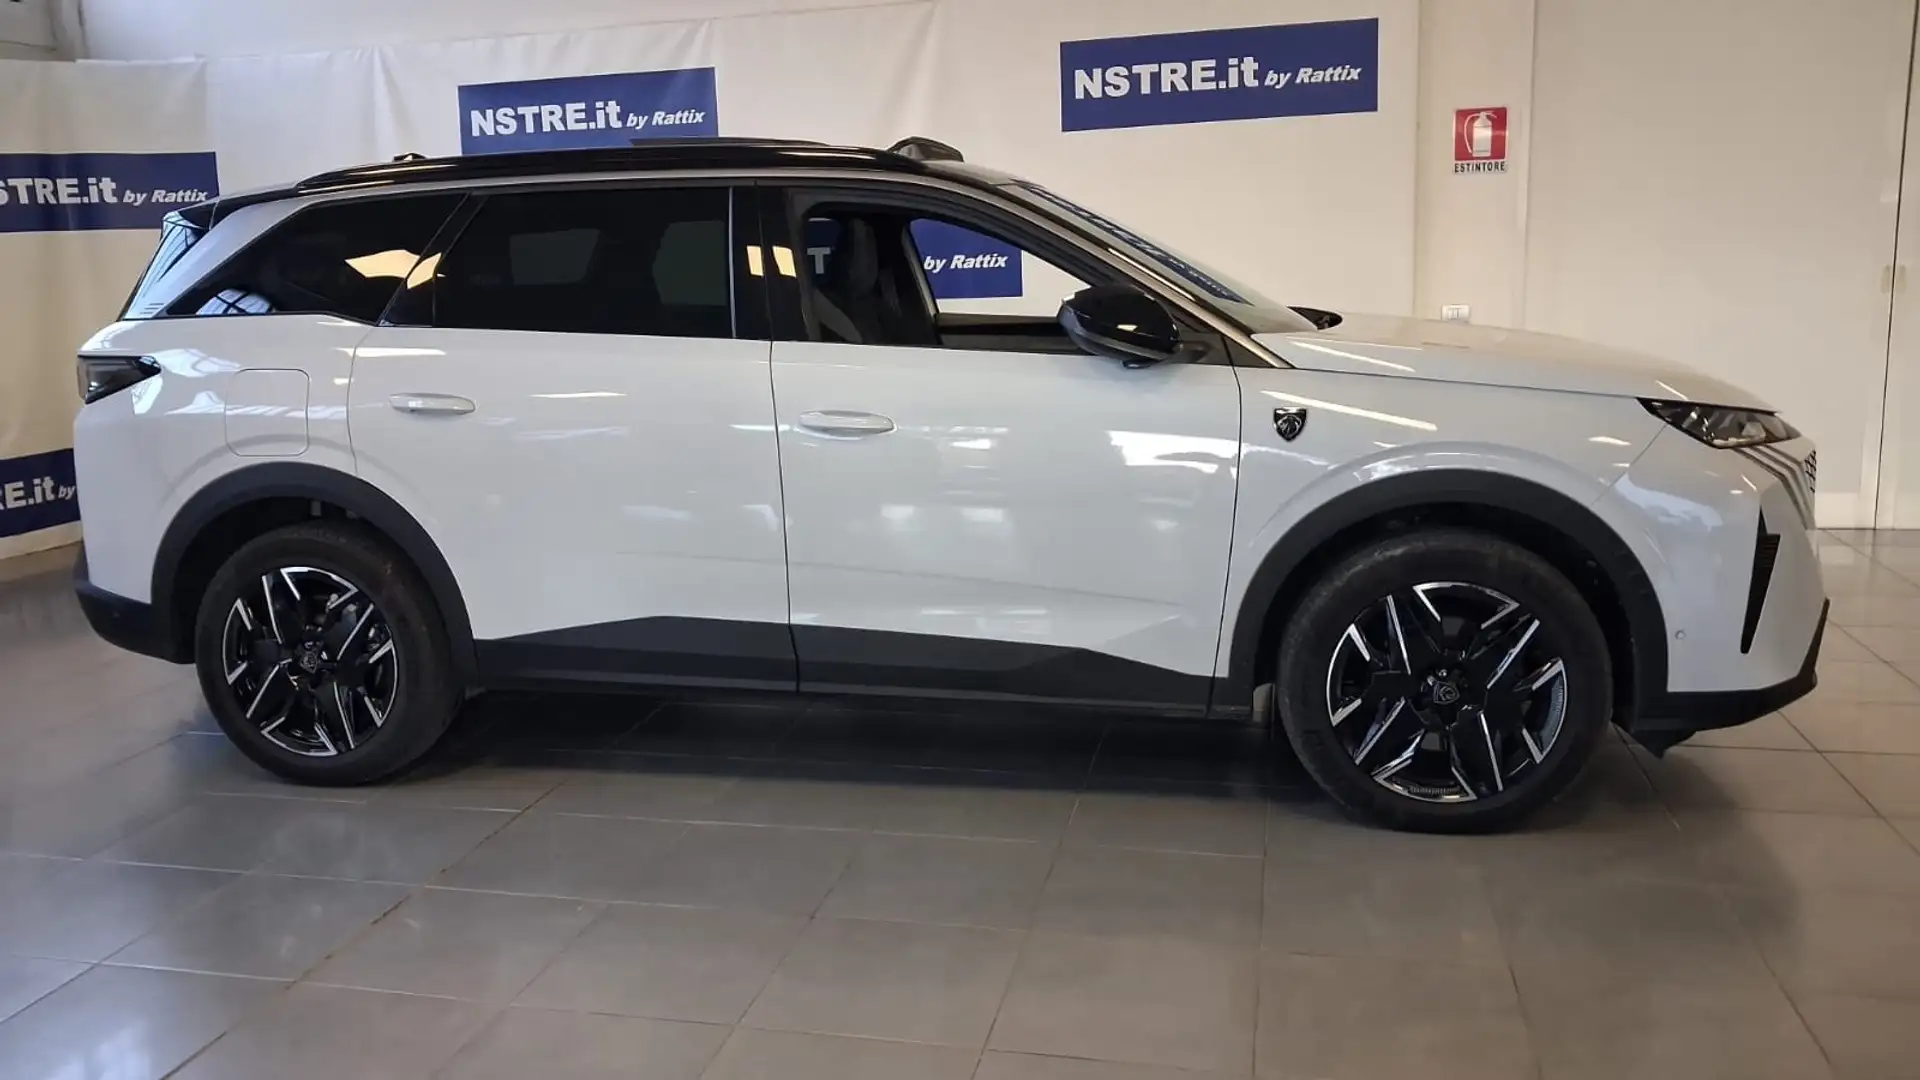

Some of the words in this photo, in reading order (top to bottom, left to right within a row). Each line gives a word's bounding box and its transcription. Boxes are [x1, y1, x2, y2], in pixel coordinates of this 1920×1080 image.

[1074, 56, 1259, 99] NSTRE.it
[1264, 70, 1291, 89] by
[1295, 64, 1362, 84] Rattix
[470, 100, 623, 137] NSTRE.it
[626, 112, 649, 130] by
[651, 109, 706, 126] Rattix
[1454, 161, 1505, 173] ESTINTORE
[122, 189, 147, 207] by
[151, 188, 209, 203] Rattix
[923, 254, 946, 274] by
[950, 253, 1009, 270] Rattix
[58, 484, 76, 500] by
